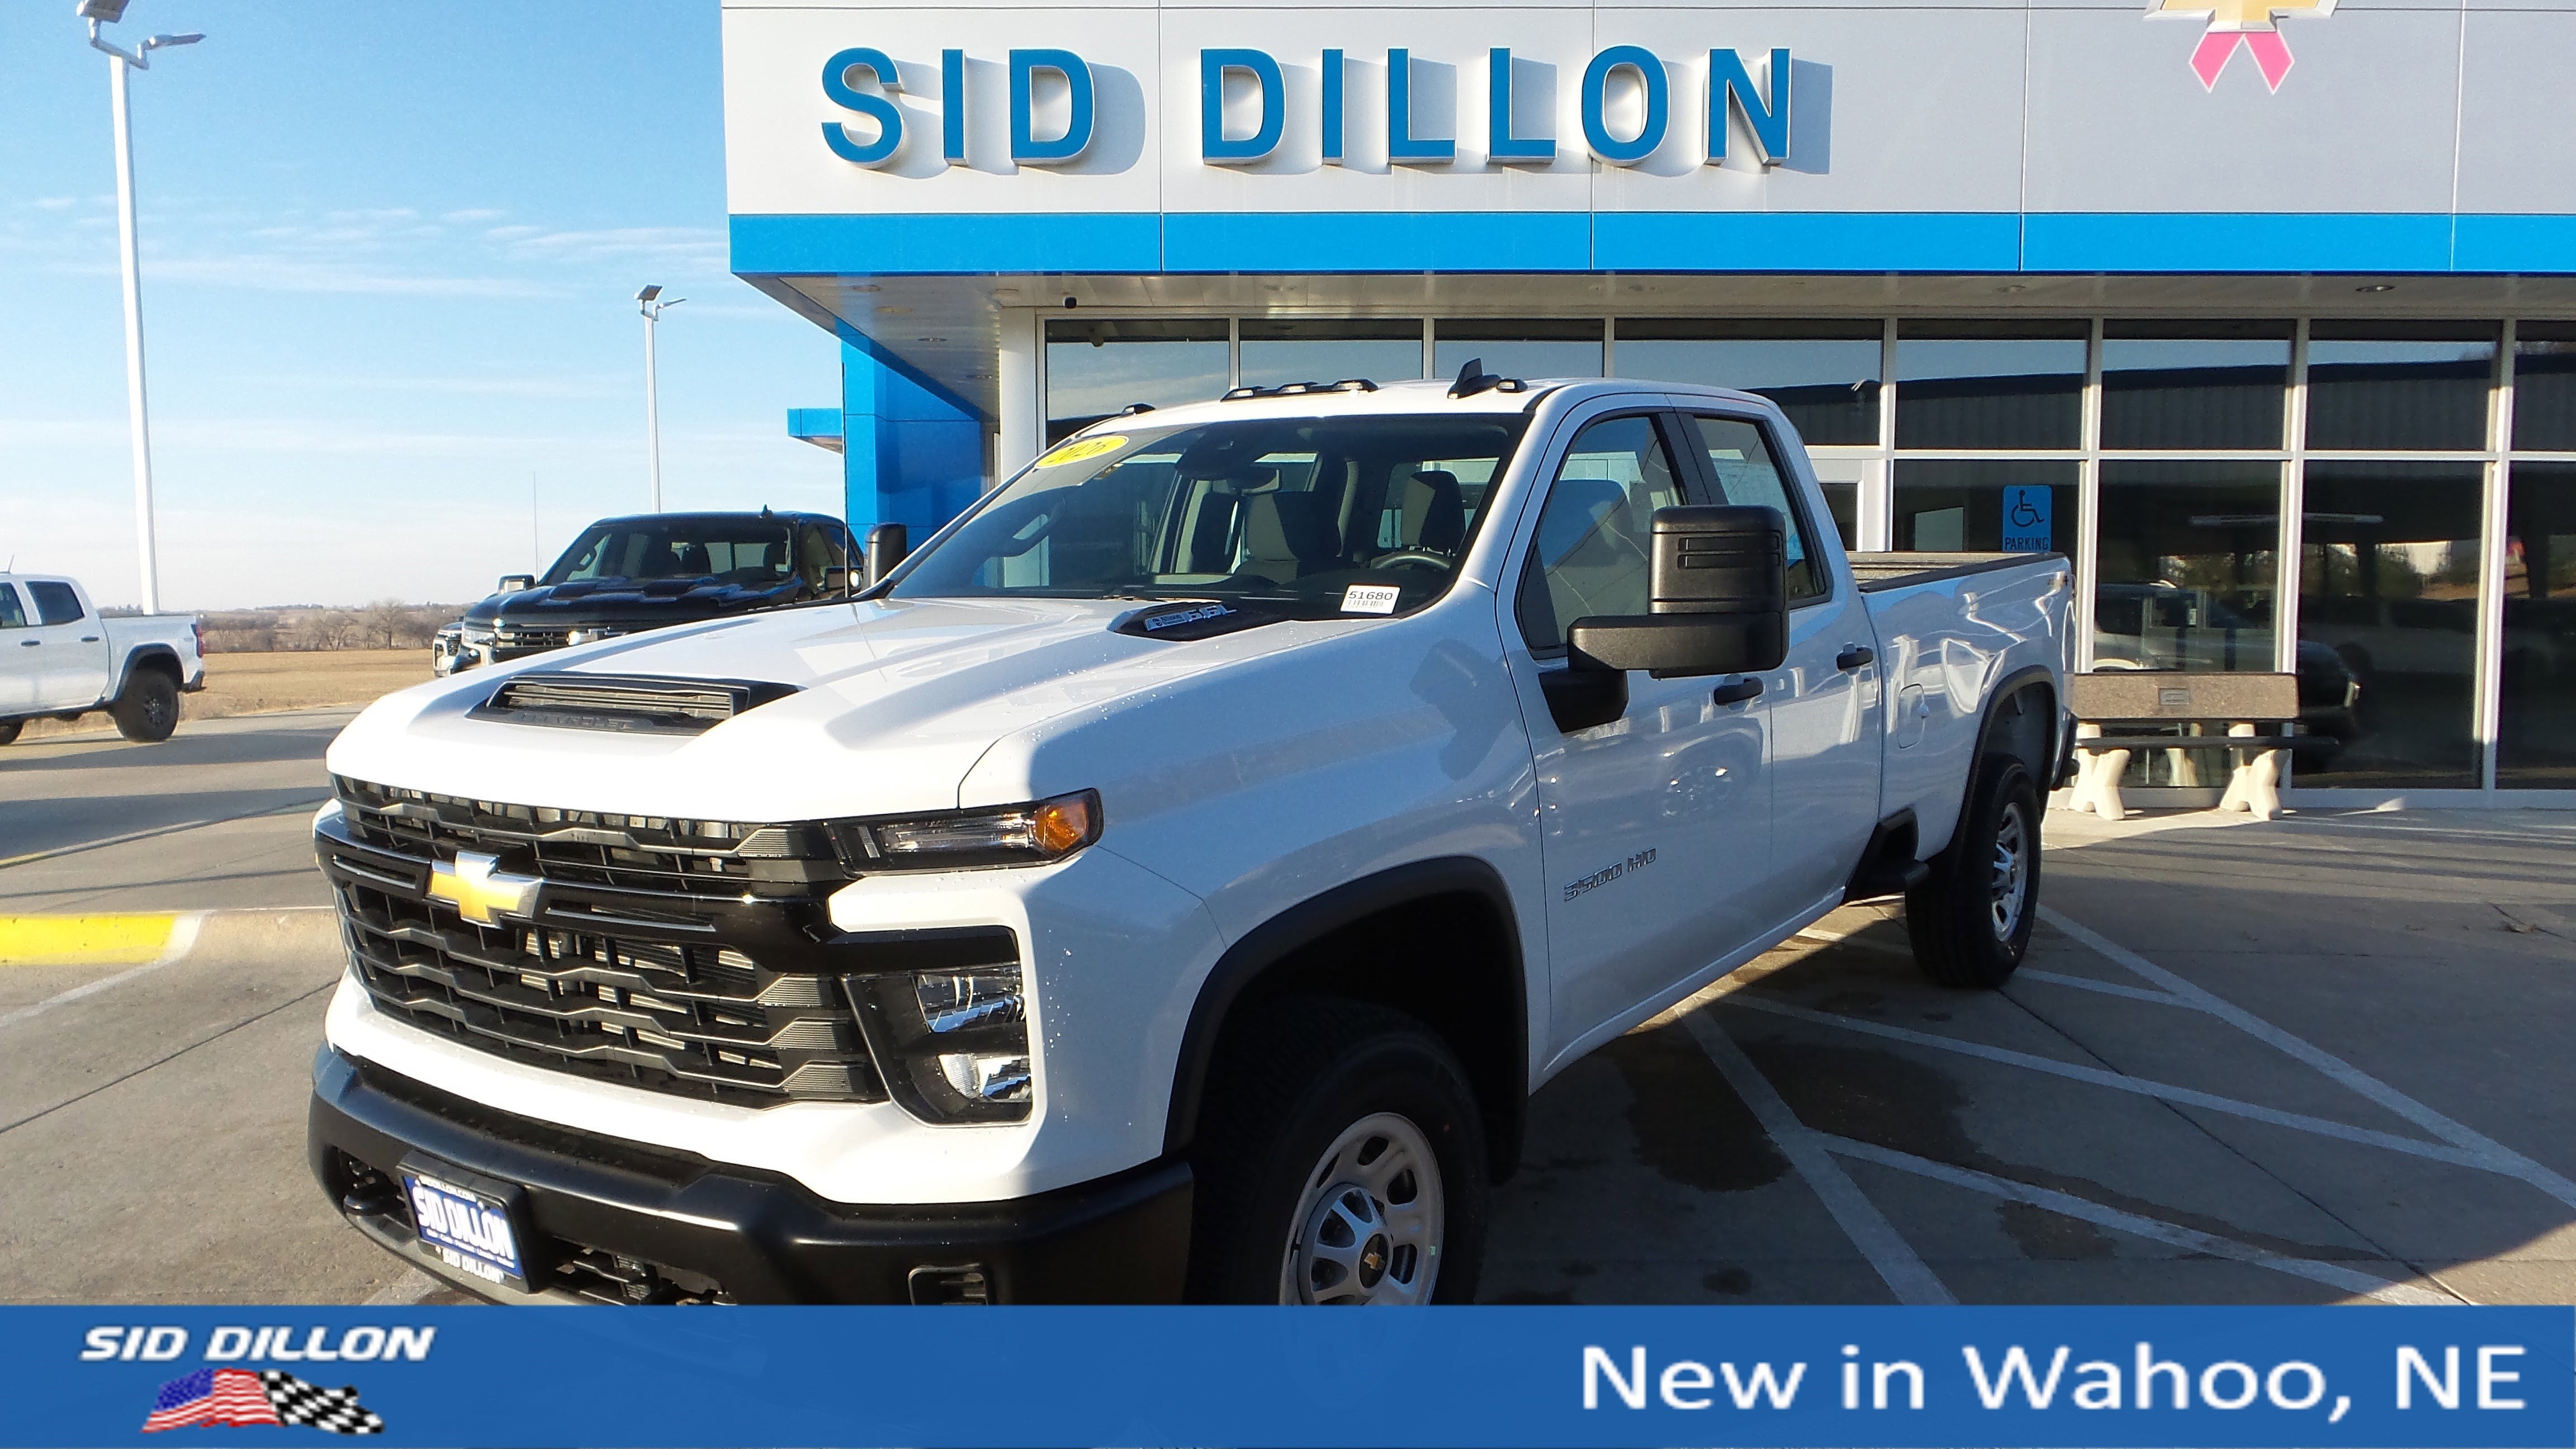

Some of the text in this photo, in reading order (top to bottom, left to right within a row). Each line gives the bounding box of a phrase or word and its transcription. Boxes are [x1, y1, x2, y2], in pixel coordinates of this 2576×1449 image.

[821, 45, 1792, 169] SID DILLON
[2004, 536, 2049, 551] PARKING
[1348, 591, 1394, 600] 51680
[1564, 847, 1656, 902] 3500 HD
[412, 1186, 447, 1234] SID
[443, 1197, 515, 1260] DILLON
[442, 1248, 461, 1268] SID
[461, 1254, 504, 1284] DILLON
